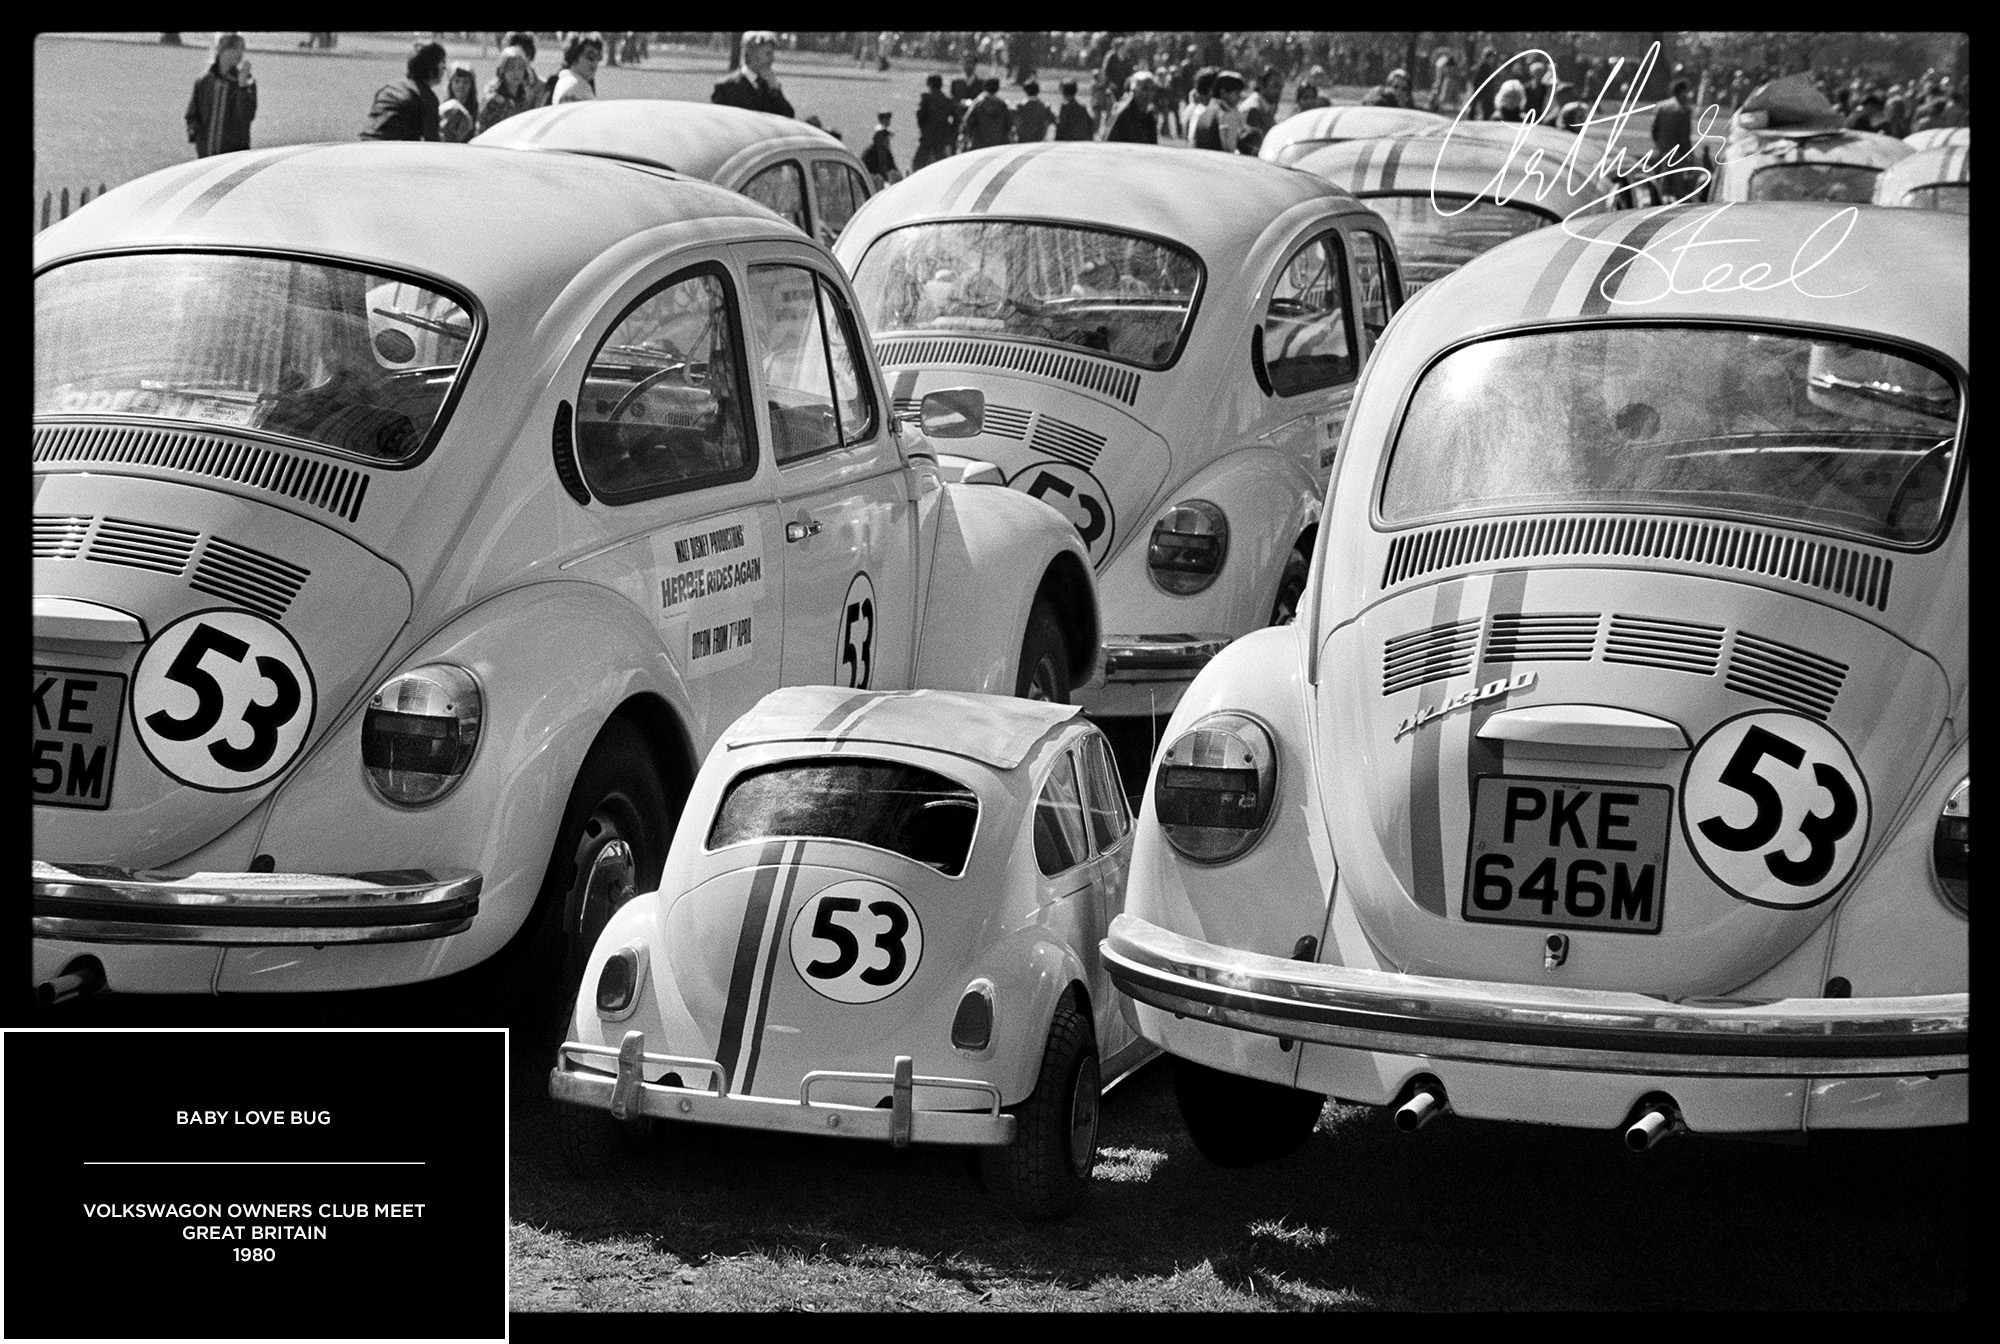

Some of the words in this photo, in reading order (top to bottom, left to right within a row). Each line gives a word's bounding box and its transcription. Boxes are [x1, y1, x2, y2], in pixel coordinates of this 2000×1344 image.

[144, 622, 302, 773] 53
[1503, 786, 1640, 852] PKE
[1697, 724, 1858, 887] 53
[1473, 853, 1656, 922] 646M
[806, 896, 909, 987] 53
